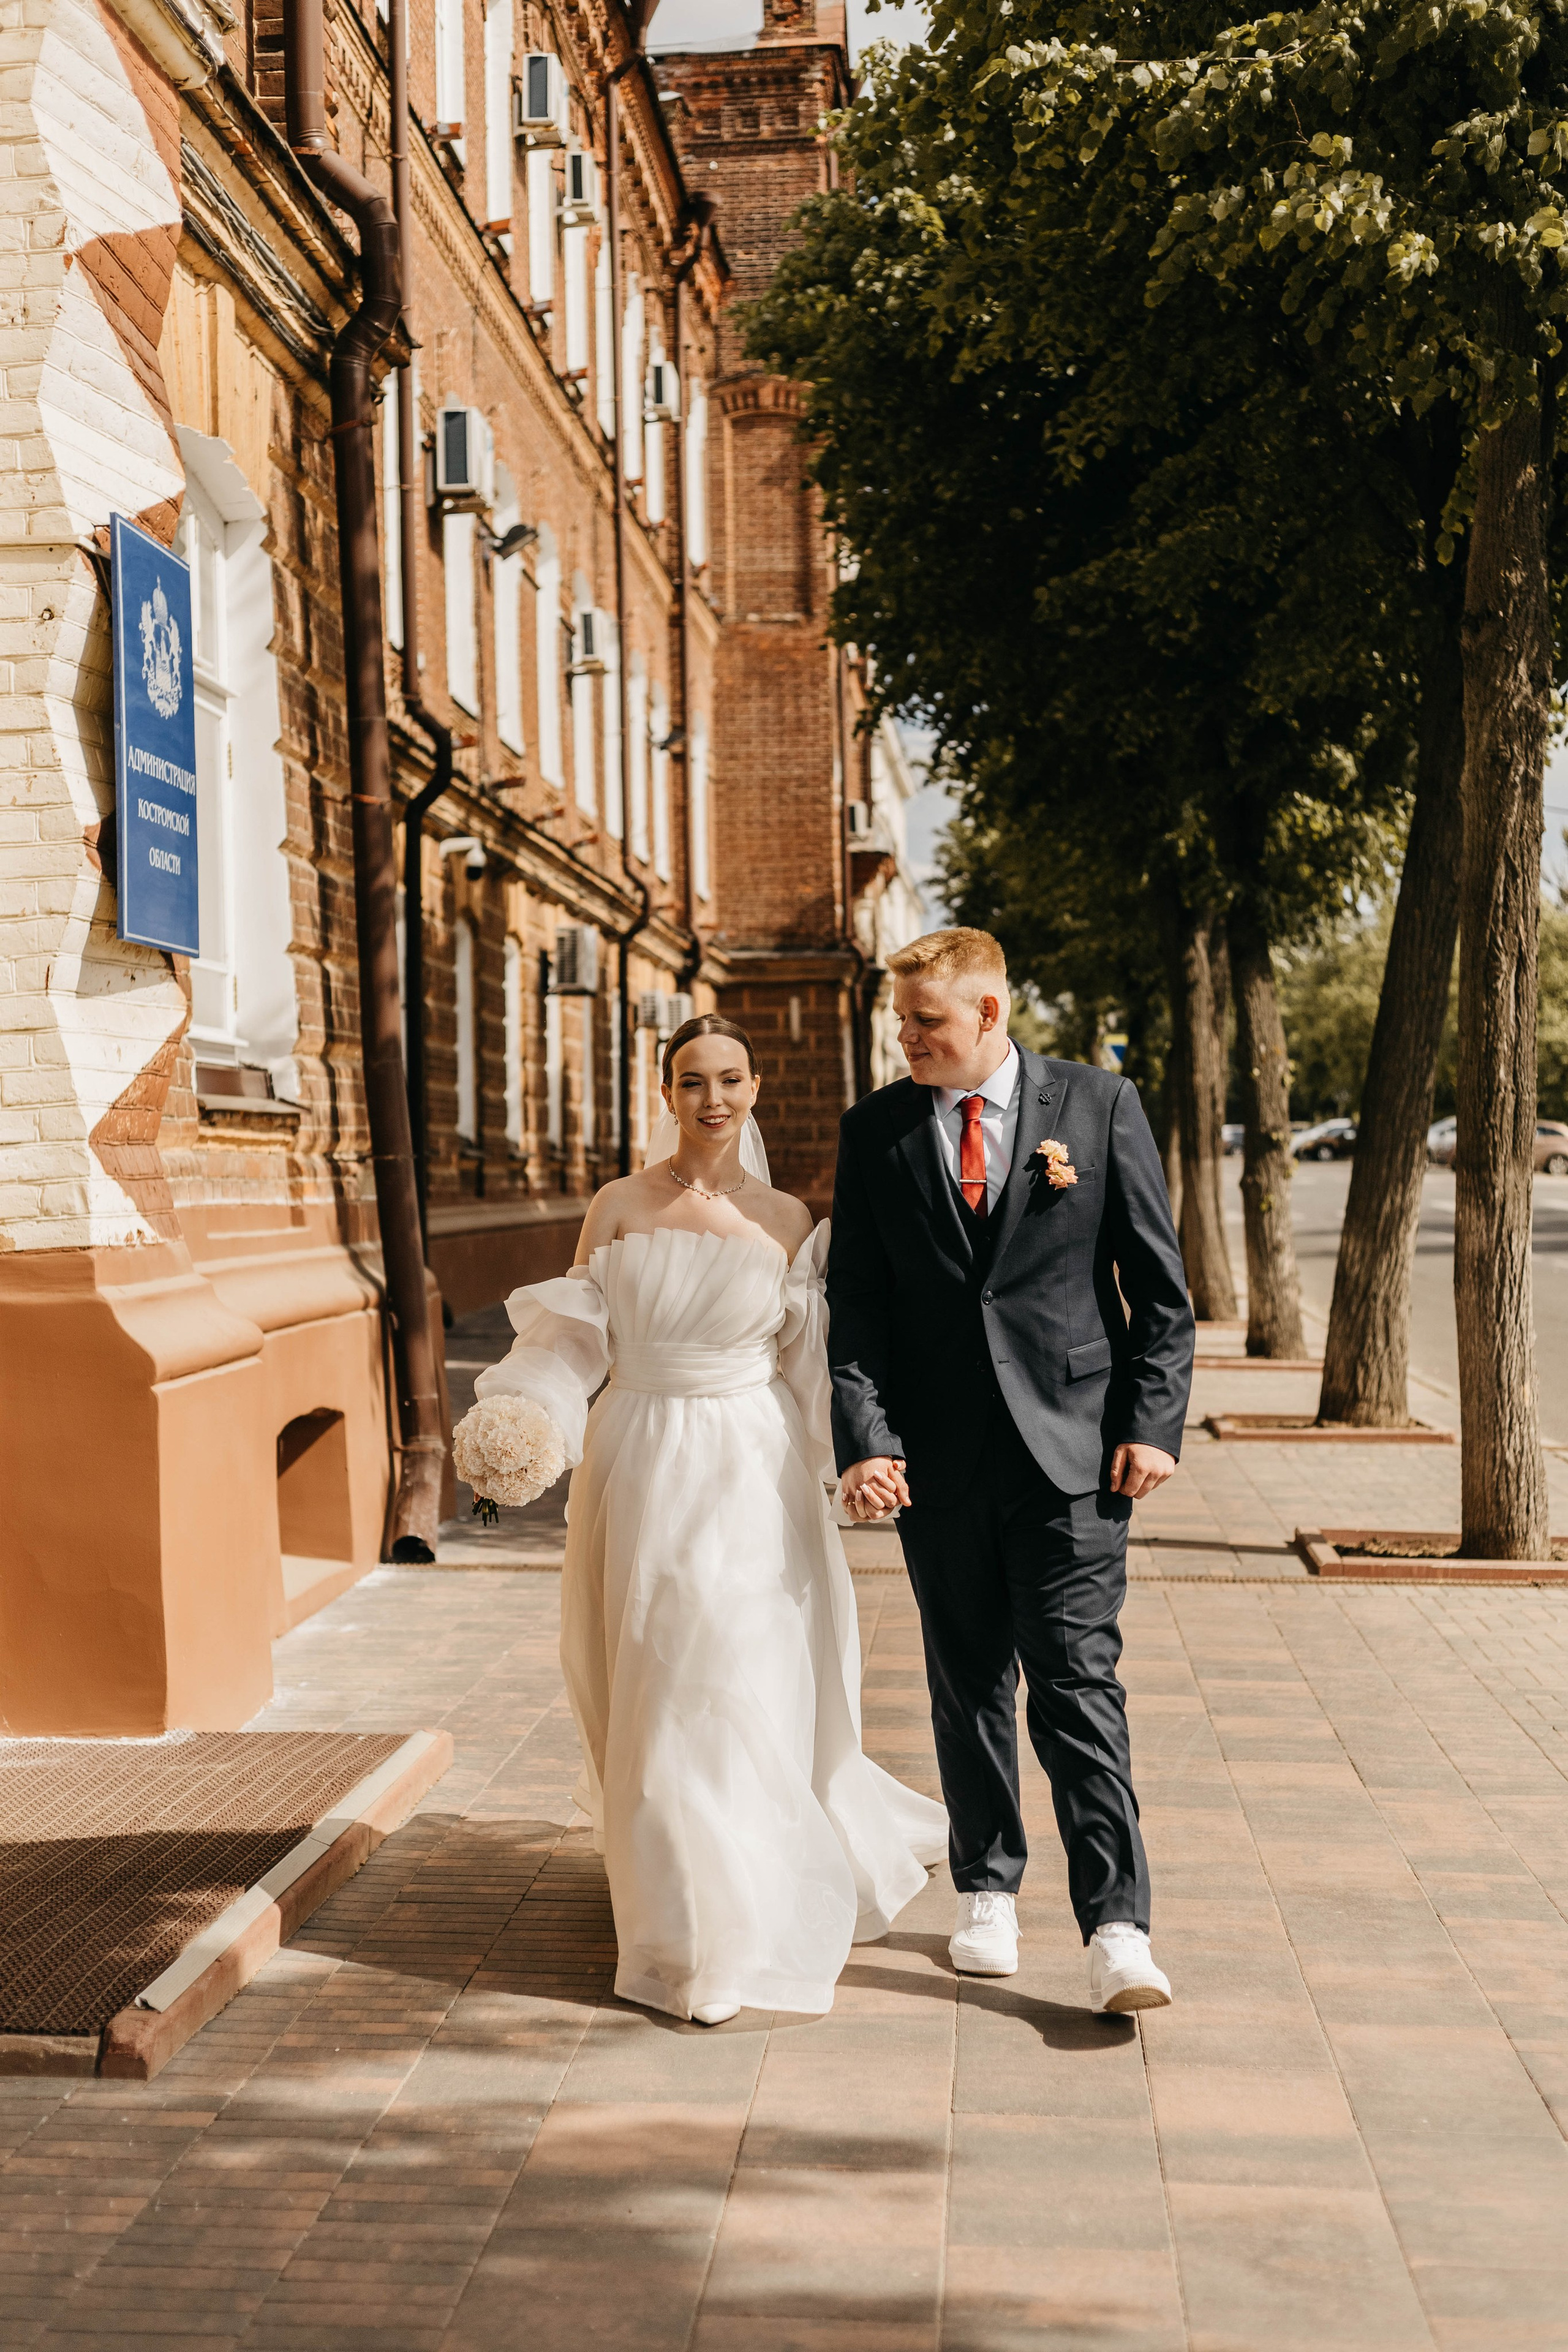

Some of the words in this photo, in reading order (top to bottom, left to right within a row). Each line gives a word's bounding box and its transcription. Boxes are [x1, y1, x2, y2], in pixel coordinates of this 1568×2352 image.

[127, 745, 195, 796] АДМИНИСТРАЦИЯ
[138, 798, 190, 837] КОСТРОМСКОЙ
[149, 846, 181, 875] ОБЛАСТИ
